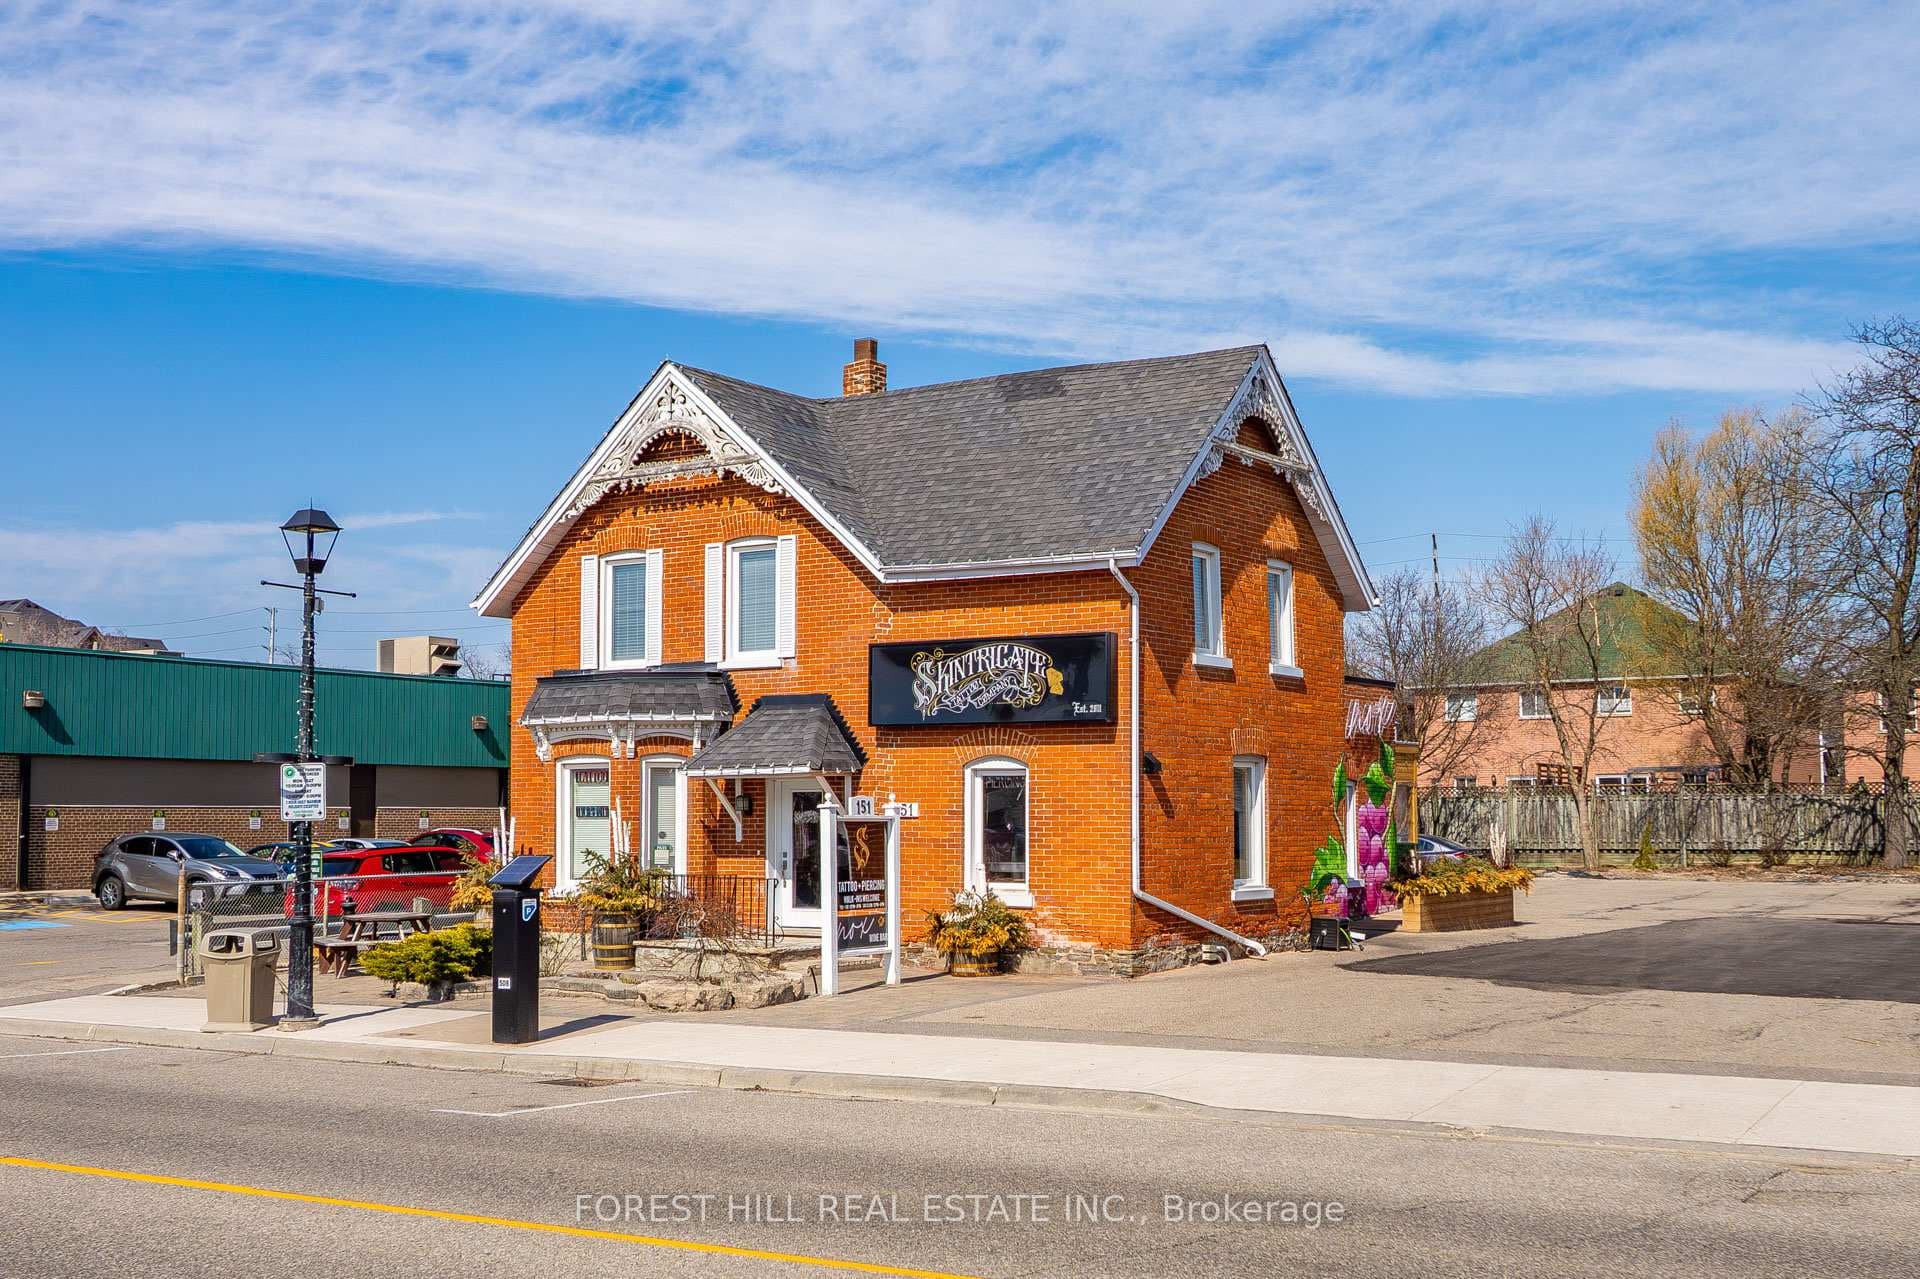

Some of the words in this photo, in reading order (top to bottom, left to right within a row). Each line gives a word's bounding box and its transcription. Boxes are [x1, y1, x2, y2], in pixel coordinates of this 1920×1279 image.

[976, 677, 1011, 706] COMPANY
[856, 800, 871, 815] 151
[900, 803, 913, 816] 51
